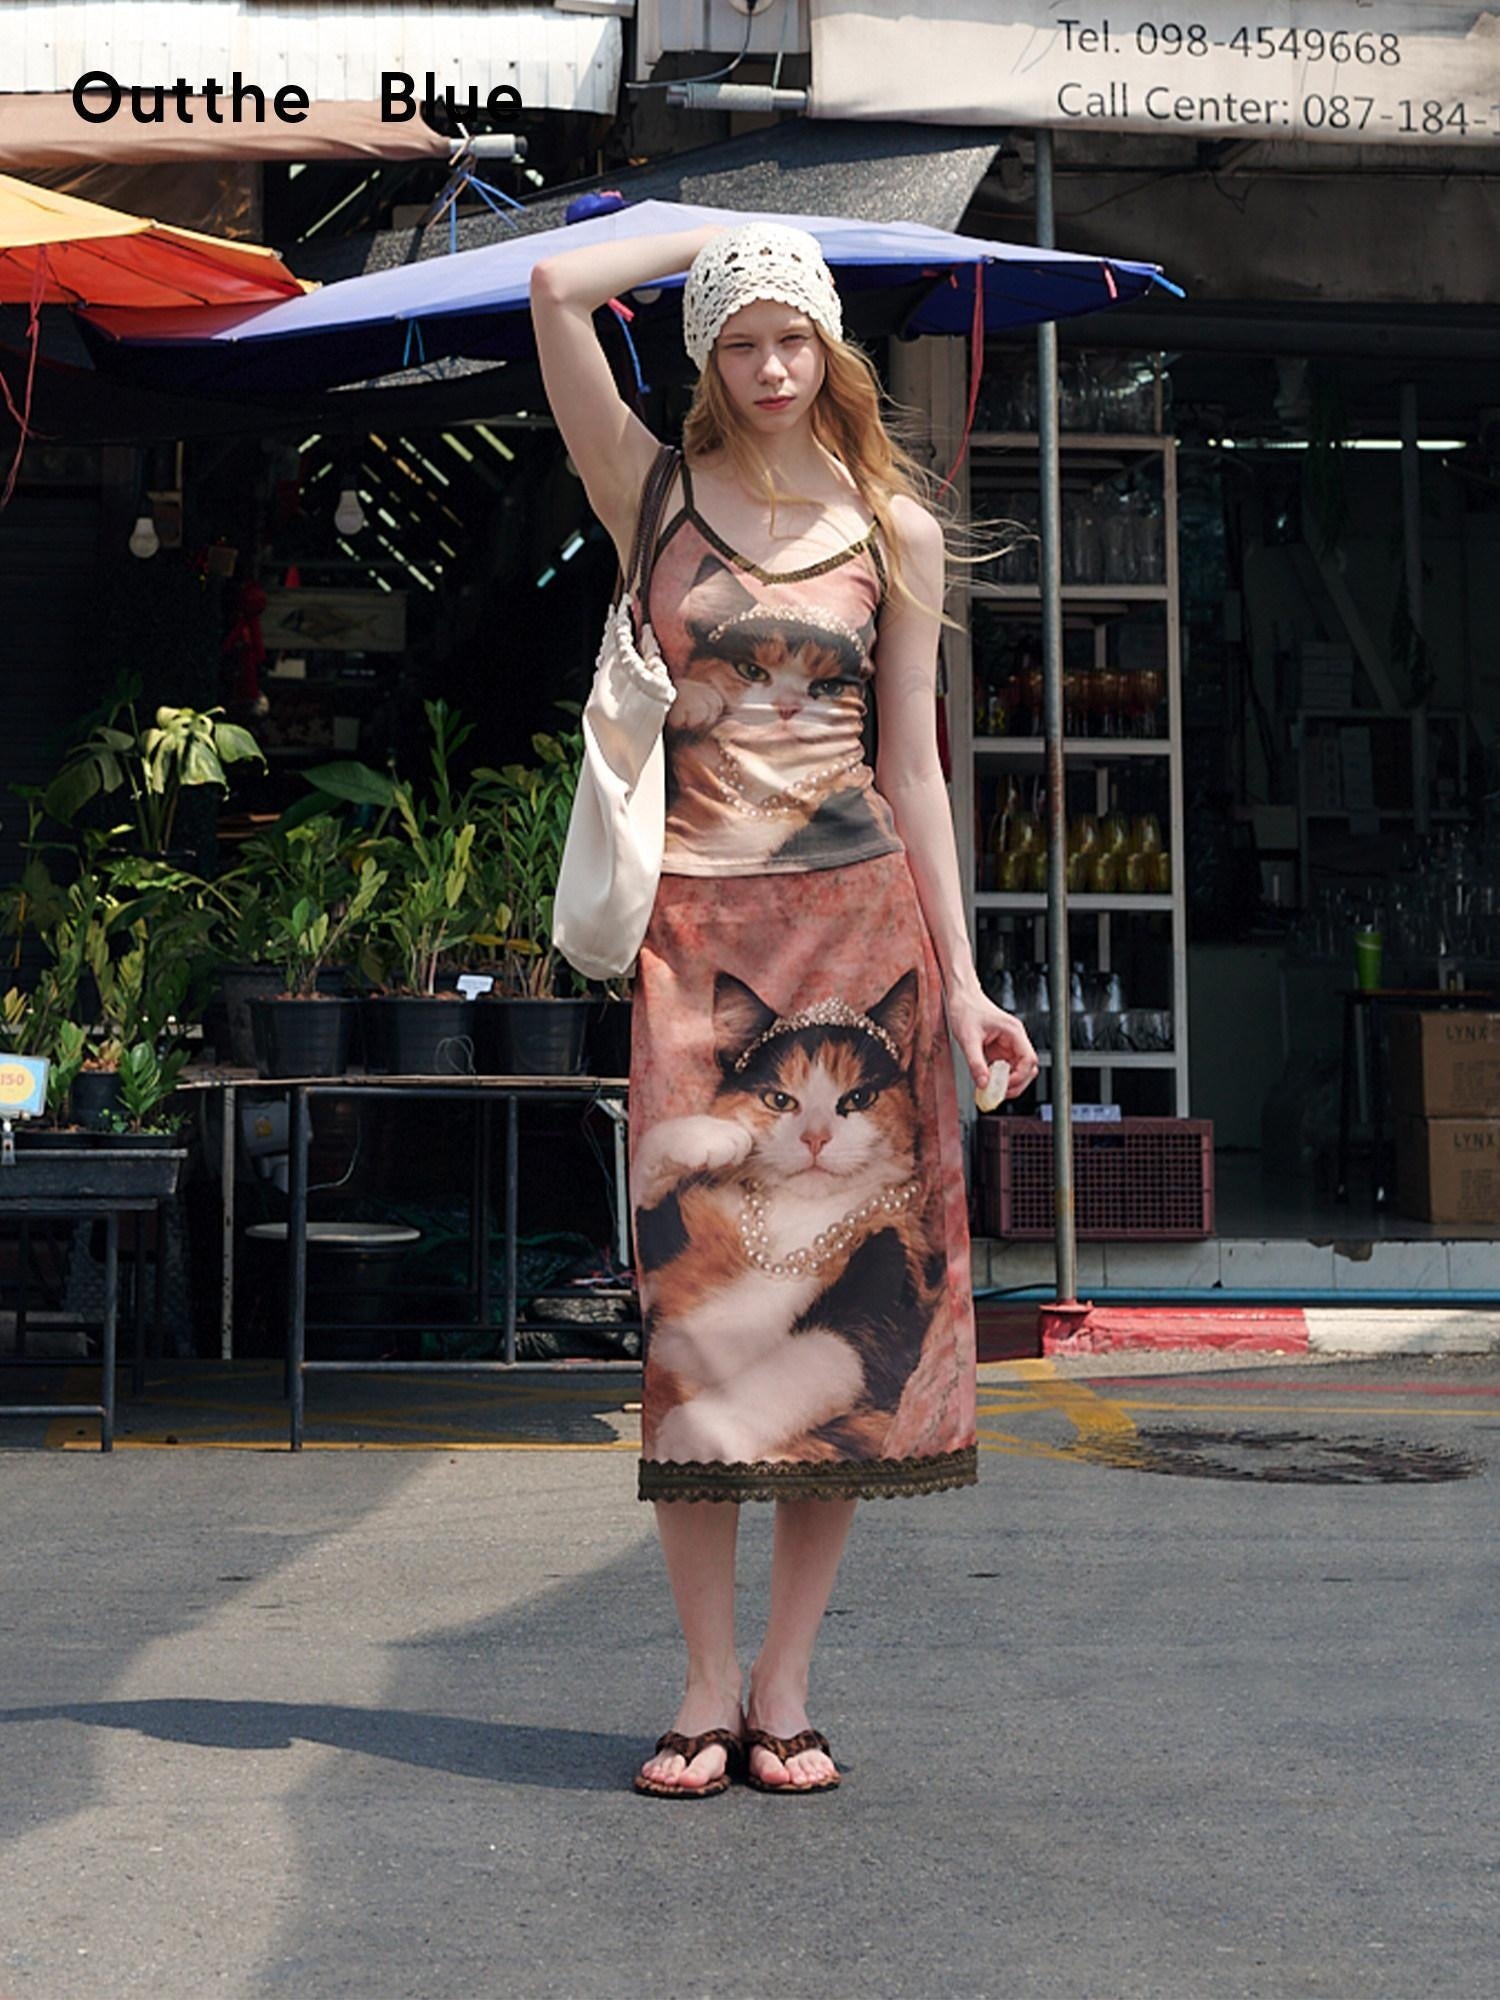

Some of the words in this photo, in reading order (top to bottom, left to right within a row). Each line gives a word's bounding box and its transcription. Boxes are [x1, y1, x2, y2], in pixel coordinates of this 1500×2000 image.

[1057, 19, 1120, 53] Tel.
[1136, 22, 1401, 66] 098-4549668
[1057, 82, 1128, 118] Call
[1145, 86, 1289, 125] Center:
[1445, 1024, 1488, 1041] LYNX
[1453, 1132, 1495, 1148] LYNX
